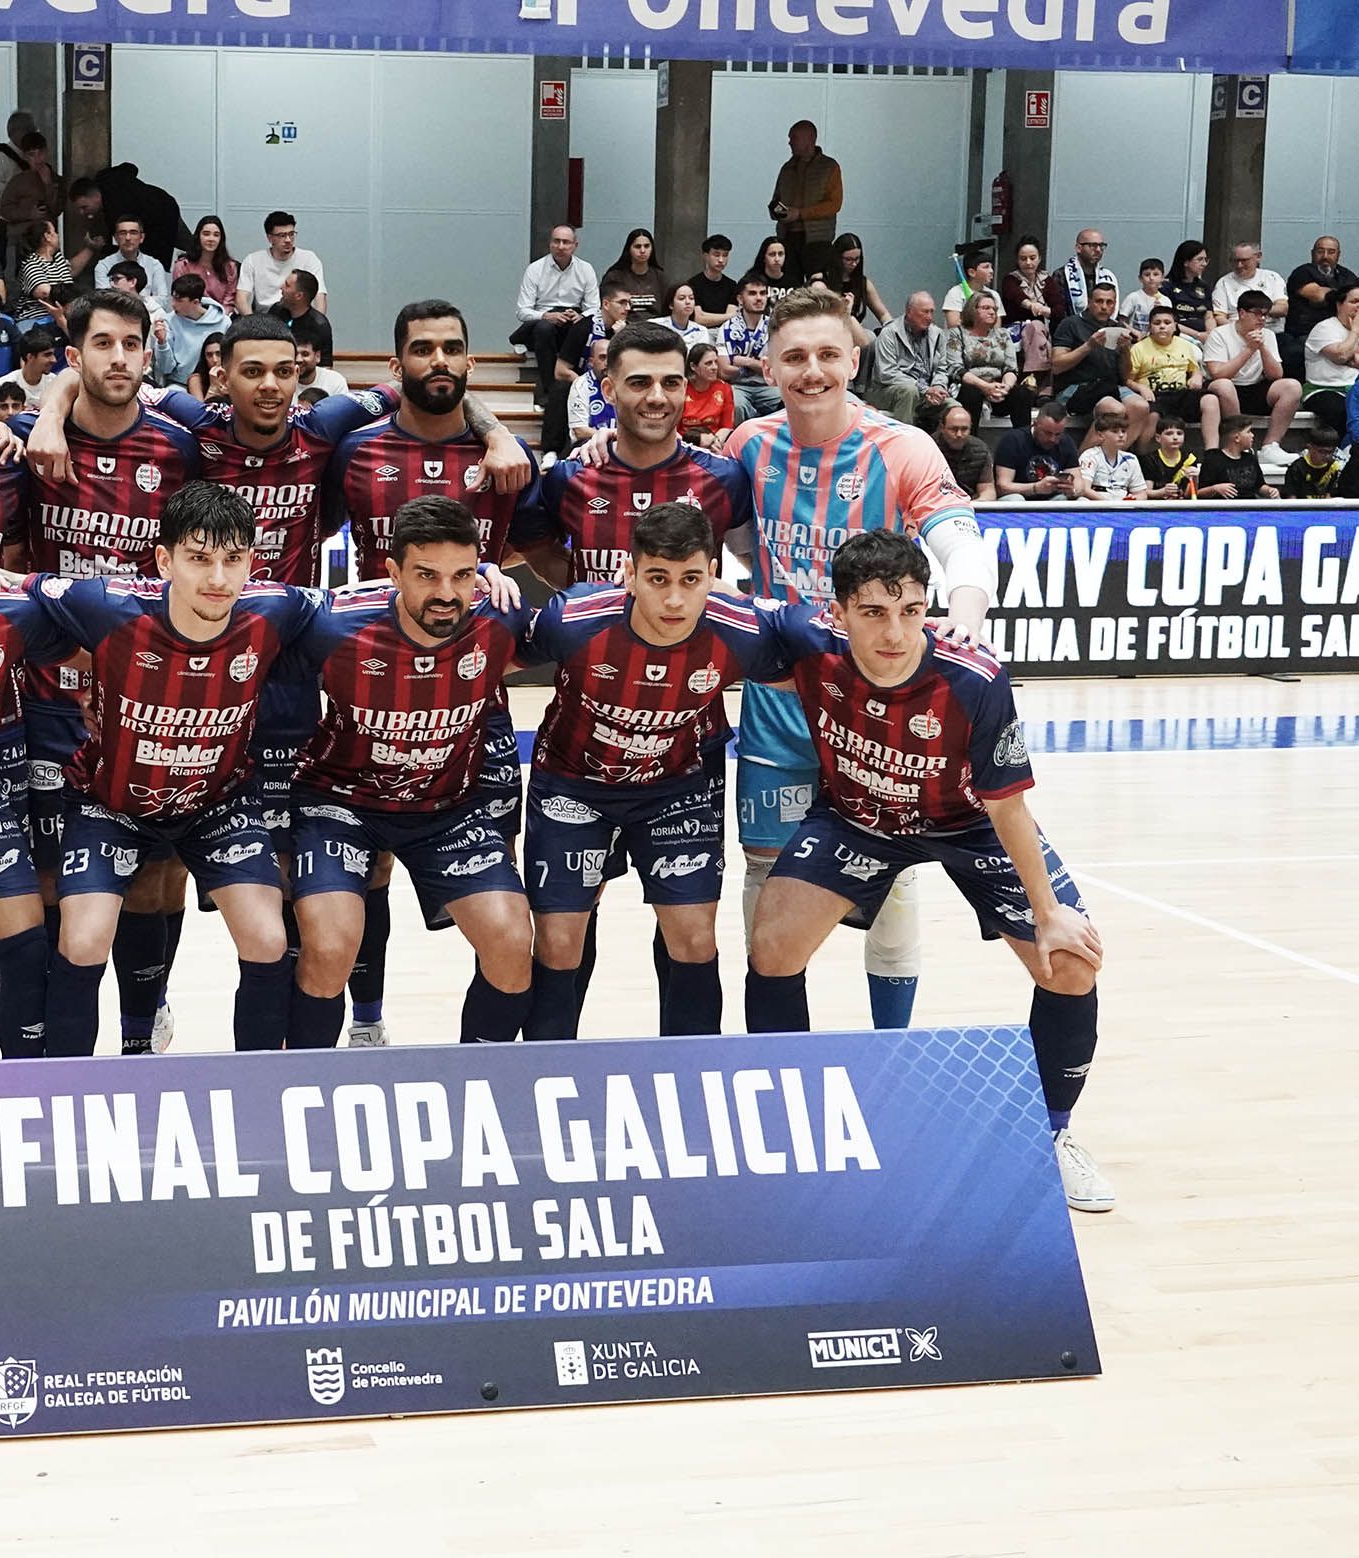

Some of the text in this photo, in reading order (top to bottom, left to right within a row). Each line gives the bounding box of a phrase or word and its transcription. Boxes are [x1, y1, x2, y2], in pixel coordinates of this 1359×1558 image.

[79, 54, 100, 77] C
[1242, 84, 1261, 106] C
[40, 502, 161, 539] TUBANOR
[59, 550, 139, 576] BigMat
[1128, 525, 1283, 607] COPA
[1089, 616, 1139, 661] DE
[1147, 607, 1290, 660] FÚTBOL
[136, 660, 159, 671] umbro
[361, 669, 385, 677] umbro
[119, 694, 254, 726] TUBANOR
[349, 697, 486, 732] TUBANOR
[120, 717, 242, 738] INSTALACIONES
[818, 706, 948, 771] TUBANOR
[135, 739, 224, 767] BigMat
[371, 741, 455, 766] BigMat
[837, 754, 921, 793] BigMat
[762, 787, 810, 809] USC
[651, 825, 684, 838] ADRIÁN
[794, 836, 820, 859] 5
[62, 848, 89, 877] 23
[296, 850, 314, 878] 11
[535, 860, 549, 888] 7
[281, 1079, 520, 1195] COPA
[533, 1066, 881, 1184] GALICIA
[250, 1195, 664, 1274] DE FÚTBOL SALA
[217, 1276, 714, 1329] PAVILLÓN MUNICIPAL DE PONTEVEDRA
[590, 1341, 658, 1361] XUNTA
[809, 1335, 900, 1361] MUNICH
[44, 1365, 183, 1389] REAL FEDERACIÓN
[350, 1360, 406, 1375] Concello
[351, 1371, 443, 1388] de Pontevedra
[593, 1357, 701, 1380] DE GALICIA
[0, 1401, 26, 1412] RFGF
[44, 1383, 191, 1408] GALEGA DE FÚTBOL
